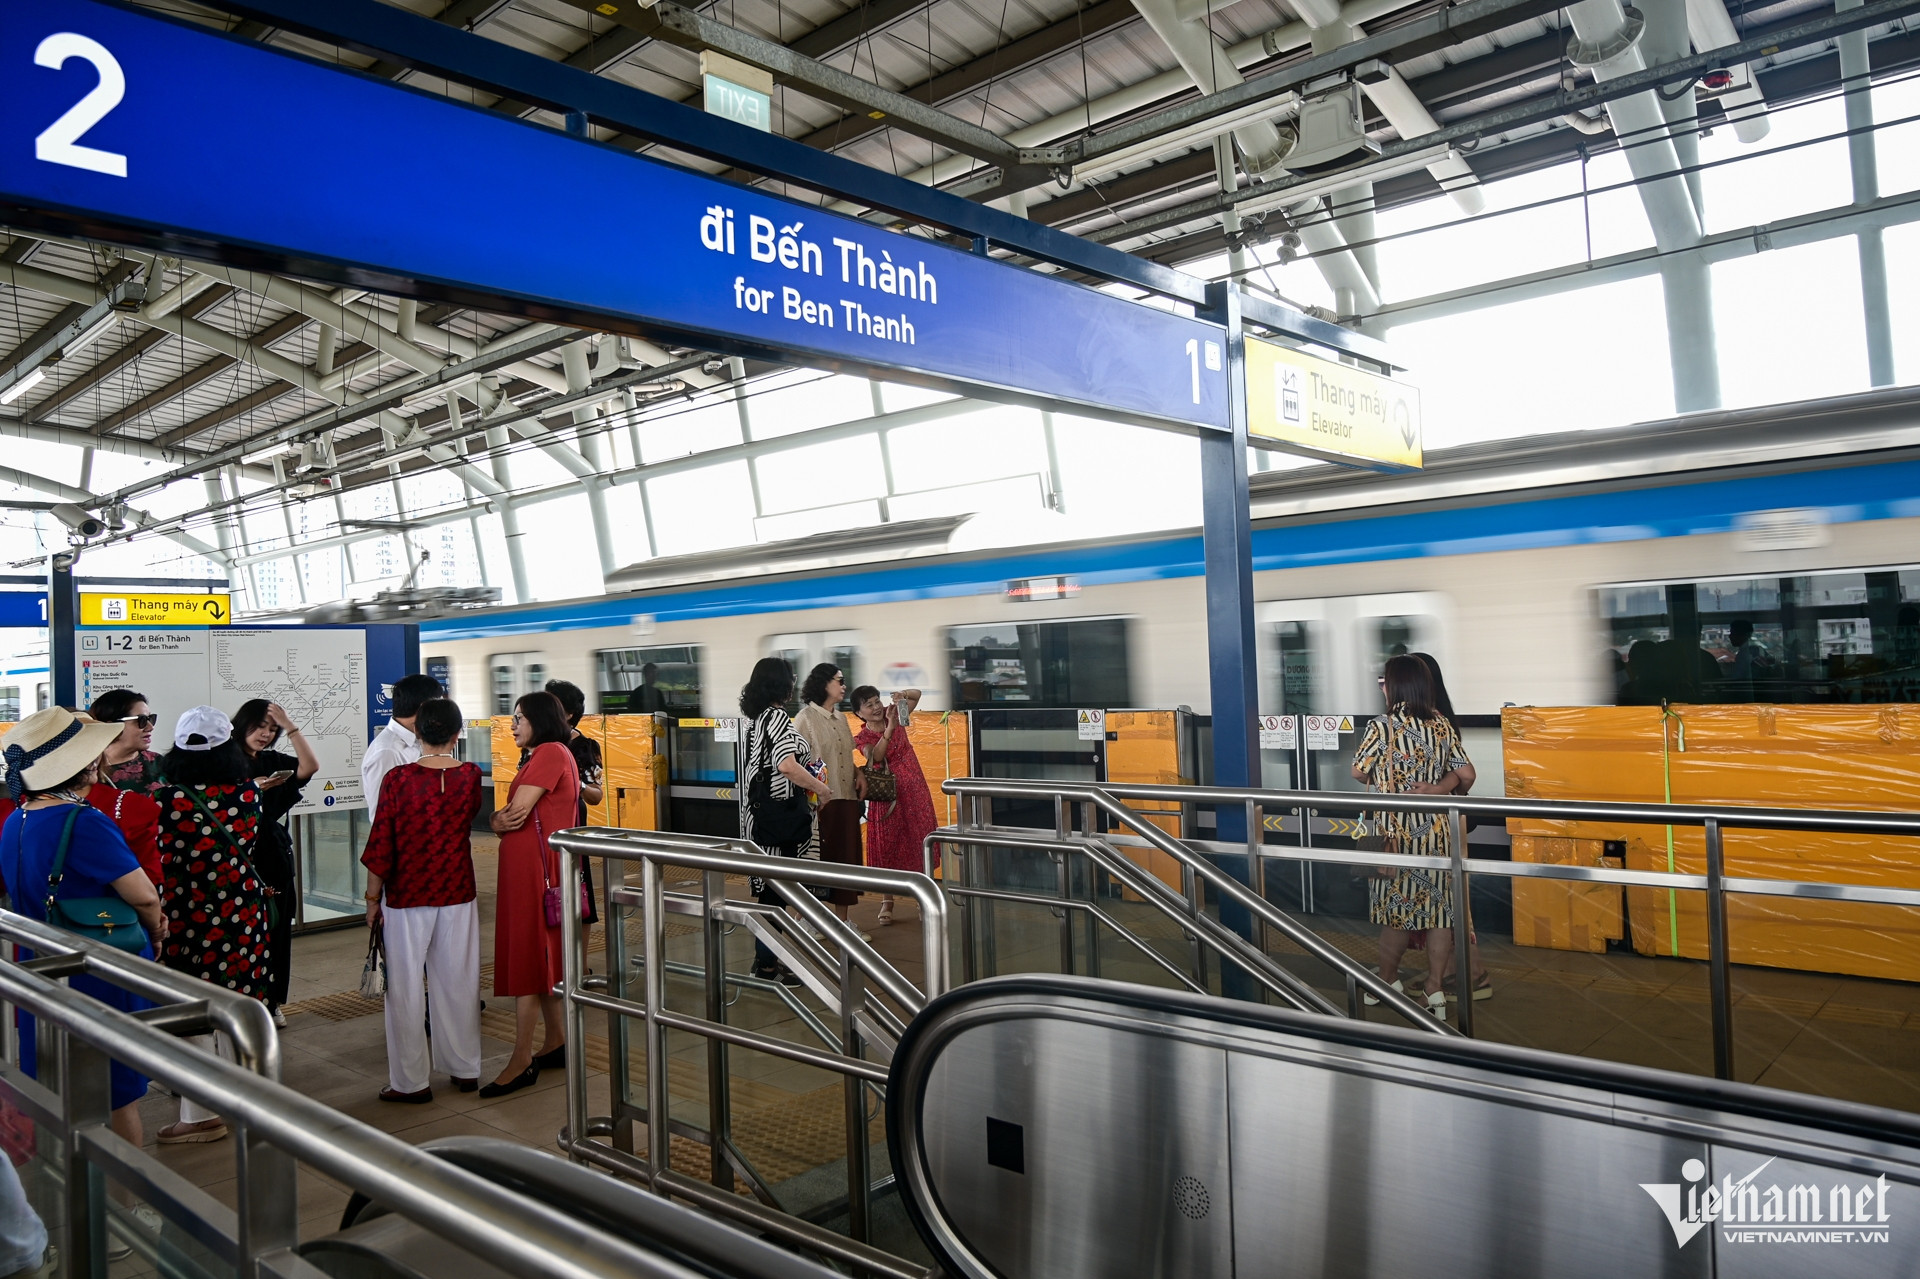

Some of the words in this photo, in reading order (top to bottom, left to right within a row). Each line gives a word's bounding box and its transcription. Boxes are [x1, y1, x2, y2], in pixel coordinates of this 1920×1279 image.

[34, 32, 127, 178] 2
[700, 205, 735, 255] đi
[750, 214, 822, 276] Bến
[833, 237, 937, 304] Thành
[734, 276, 774, 314] for
[783, 286, 833, 328] Ben
[840, 299, 915, 345] Thanh
[1186, 338, 1200, 405] 1
[1310, 371, 1355, 415] Thang
[1361, 388, 1387, 423] máy
[1311, 411, 1353, 439] Elevator
[38, 599, 47, 620] 1
[131, 599, 169, 612] Thang
[173, 599, 198, 612] máy
[131, 613, 166, 621] Elevator
[148, 634, 164, 642] Bến
[167, 634, 191, 642] Thành
